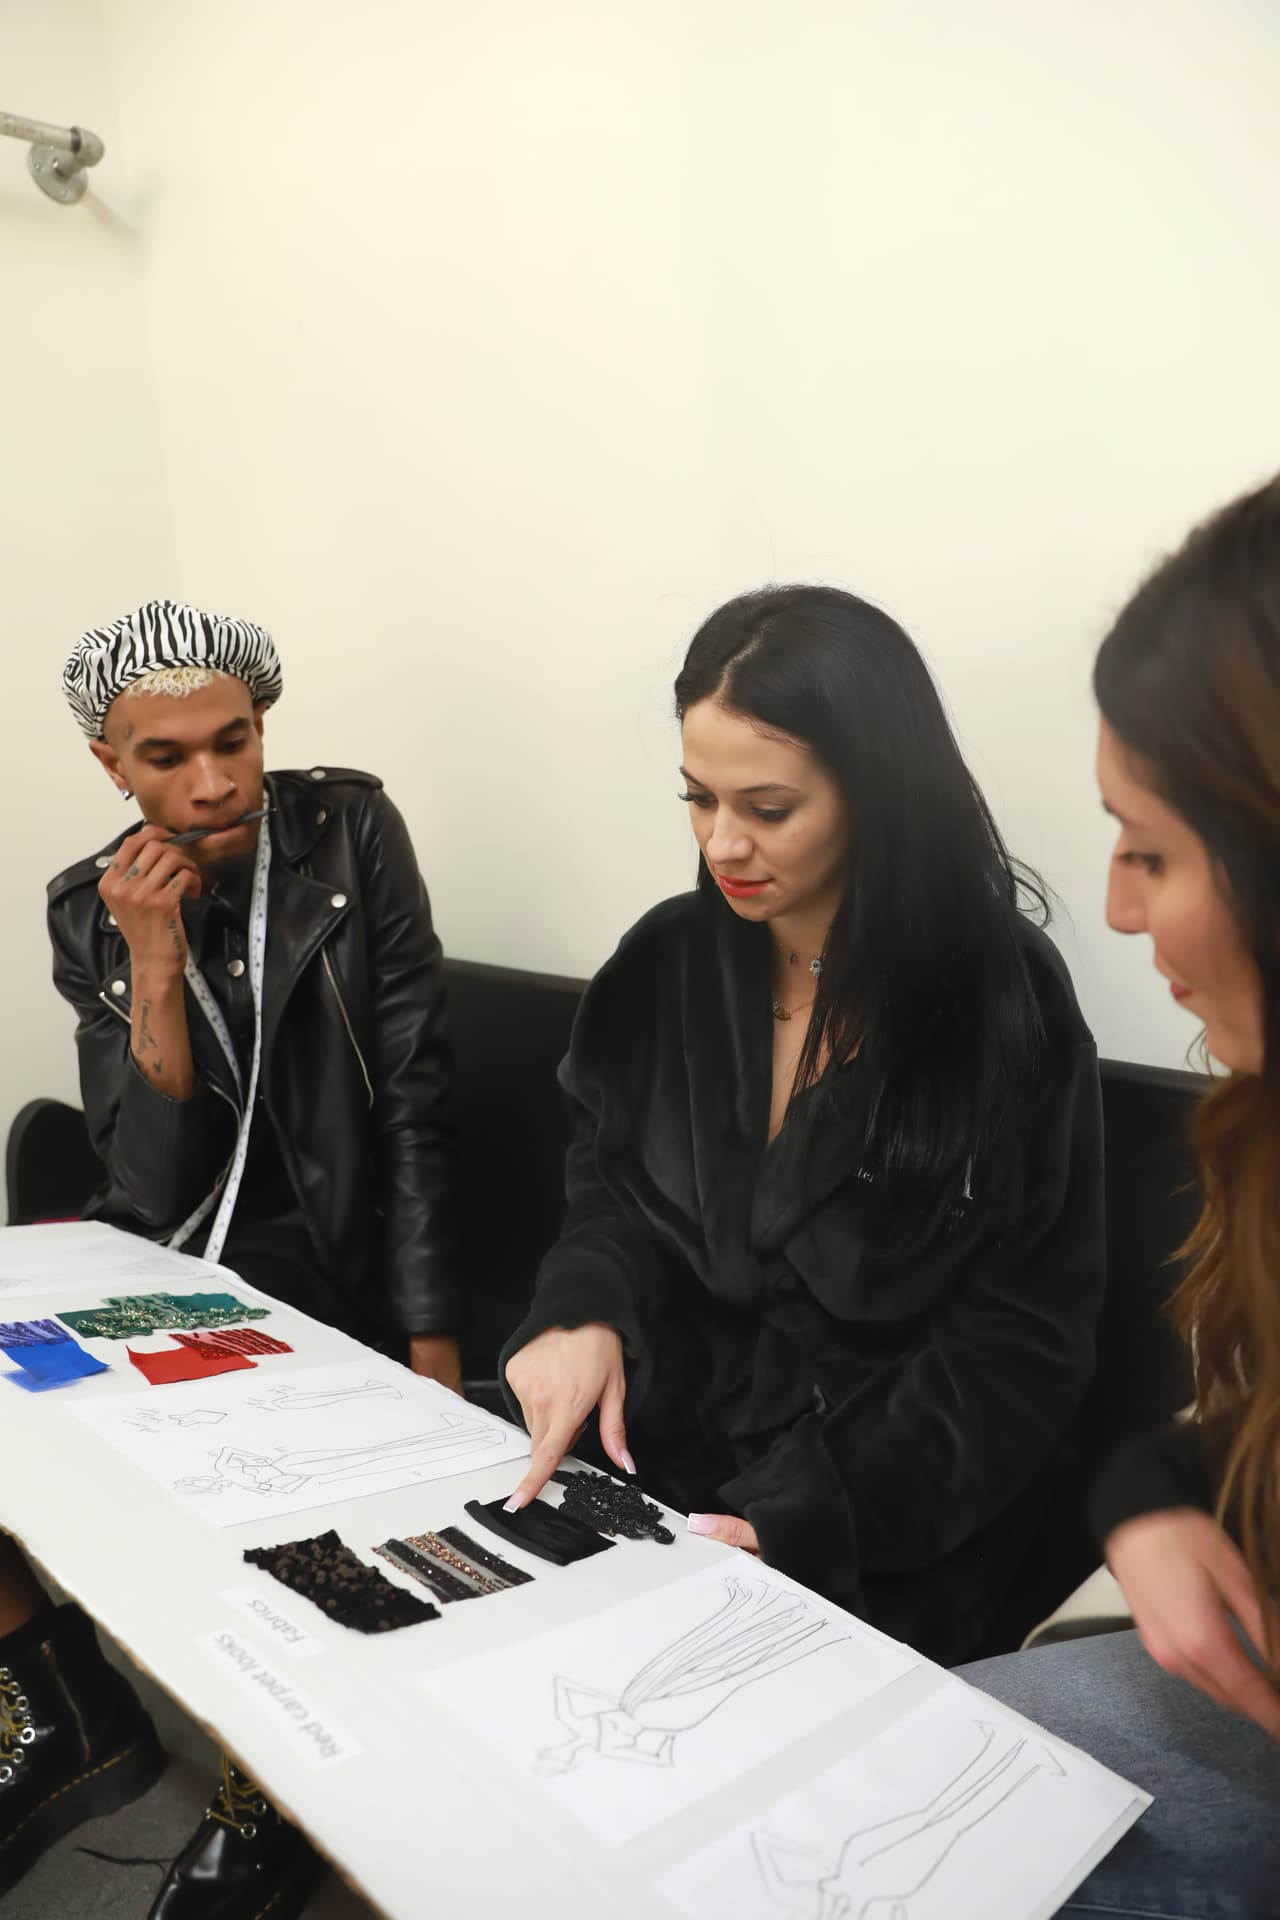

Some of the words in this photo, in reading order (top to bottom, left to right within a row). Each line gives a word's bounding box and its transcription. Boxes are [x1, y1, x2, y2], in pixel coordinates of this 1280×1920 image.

[247, 1599, 304, 1643] Fabrics
[215, 1632, 260, 1672] looks
[251, 1671, 309, 1720] carpet
[298, 1721, 343, 1758] Red
